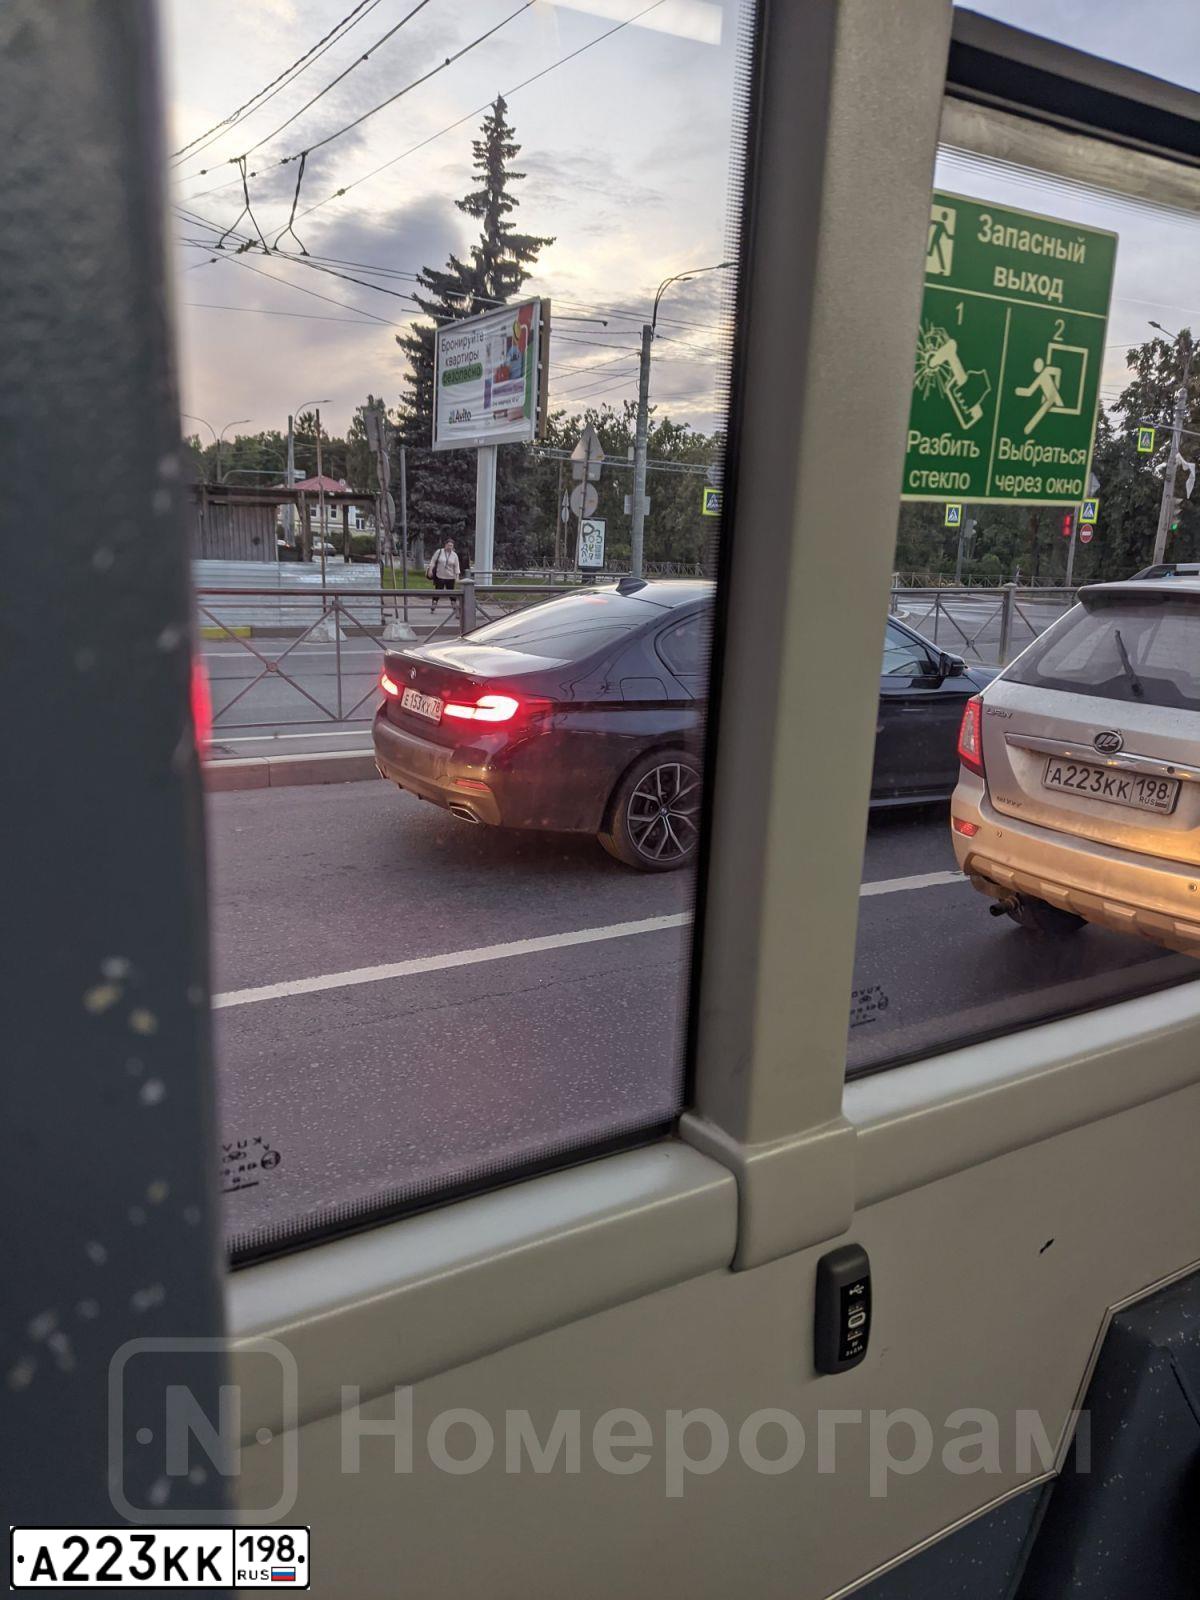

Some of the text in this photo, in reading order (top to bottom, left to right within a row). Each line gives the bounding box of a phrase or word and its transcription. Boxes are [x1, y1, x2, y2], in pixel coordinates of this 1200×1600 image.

[977, 213, 1086, 264] Запасный
[993, 266, 1064, 303] выход
[955, 301, 965, 326] 1
[1052, 319, 1065, 341] 2
[906, 430, 981, 458] Разбить
[997, 437, 1087, 467] Выбраться
[909, 470, 971, 490] стекло
[995, 474, 1083, 497] через окно
[1136, 778, 1168, 801] 198
[1139, 796, 1156, 807] RUS
